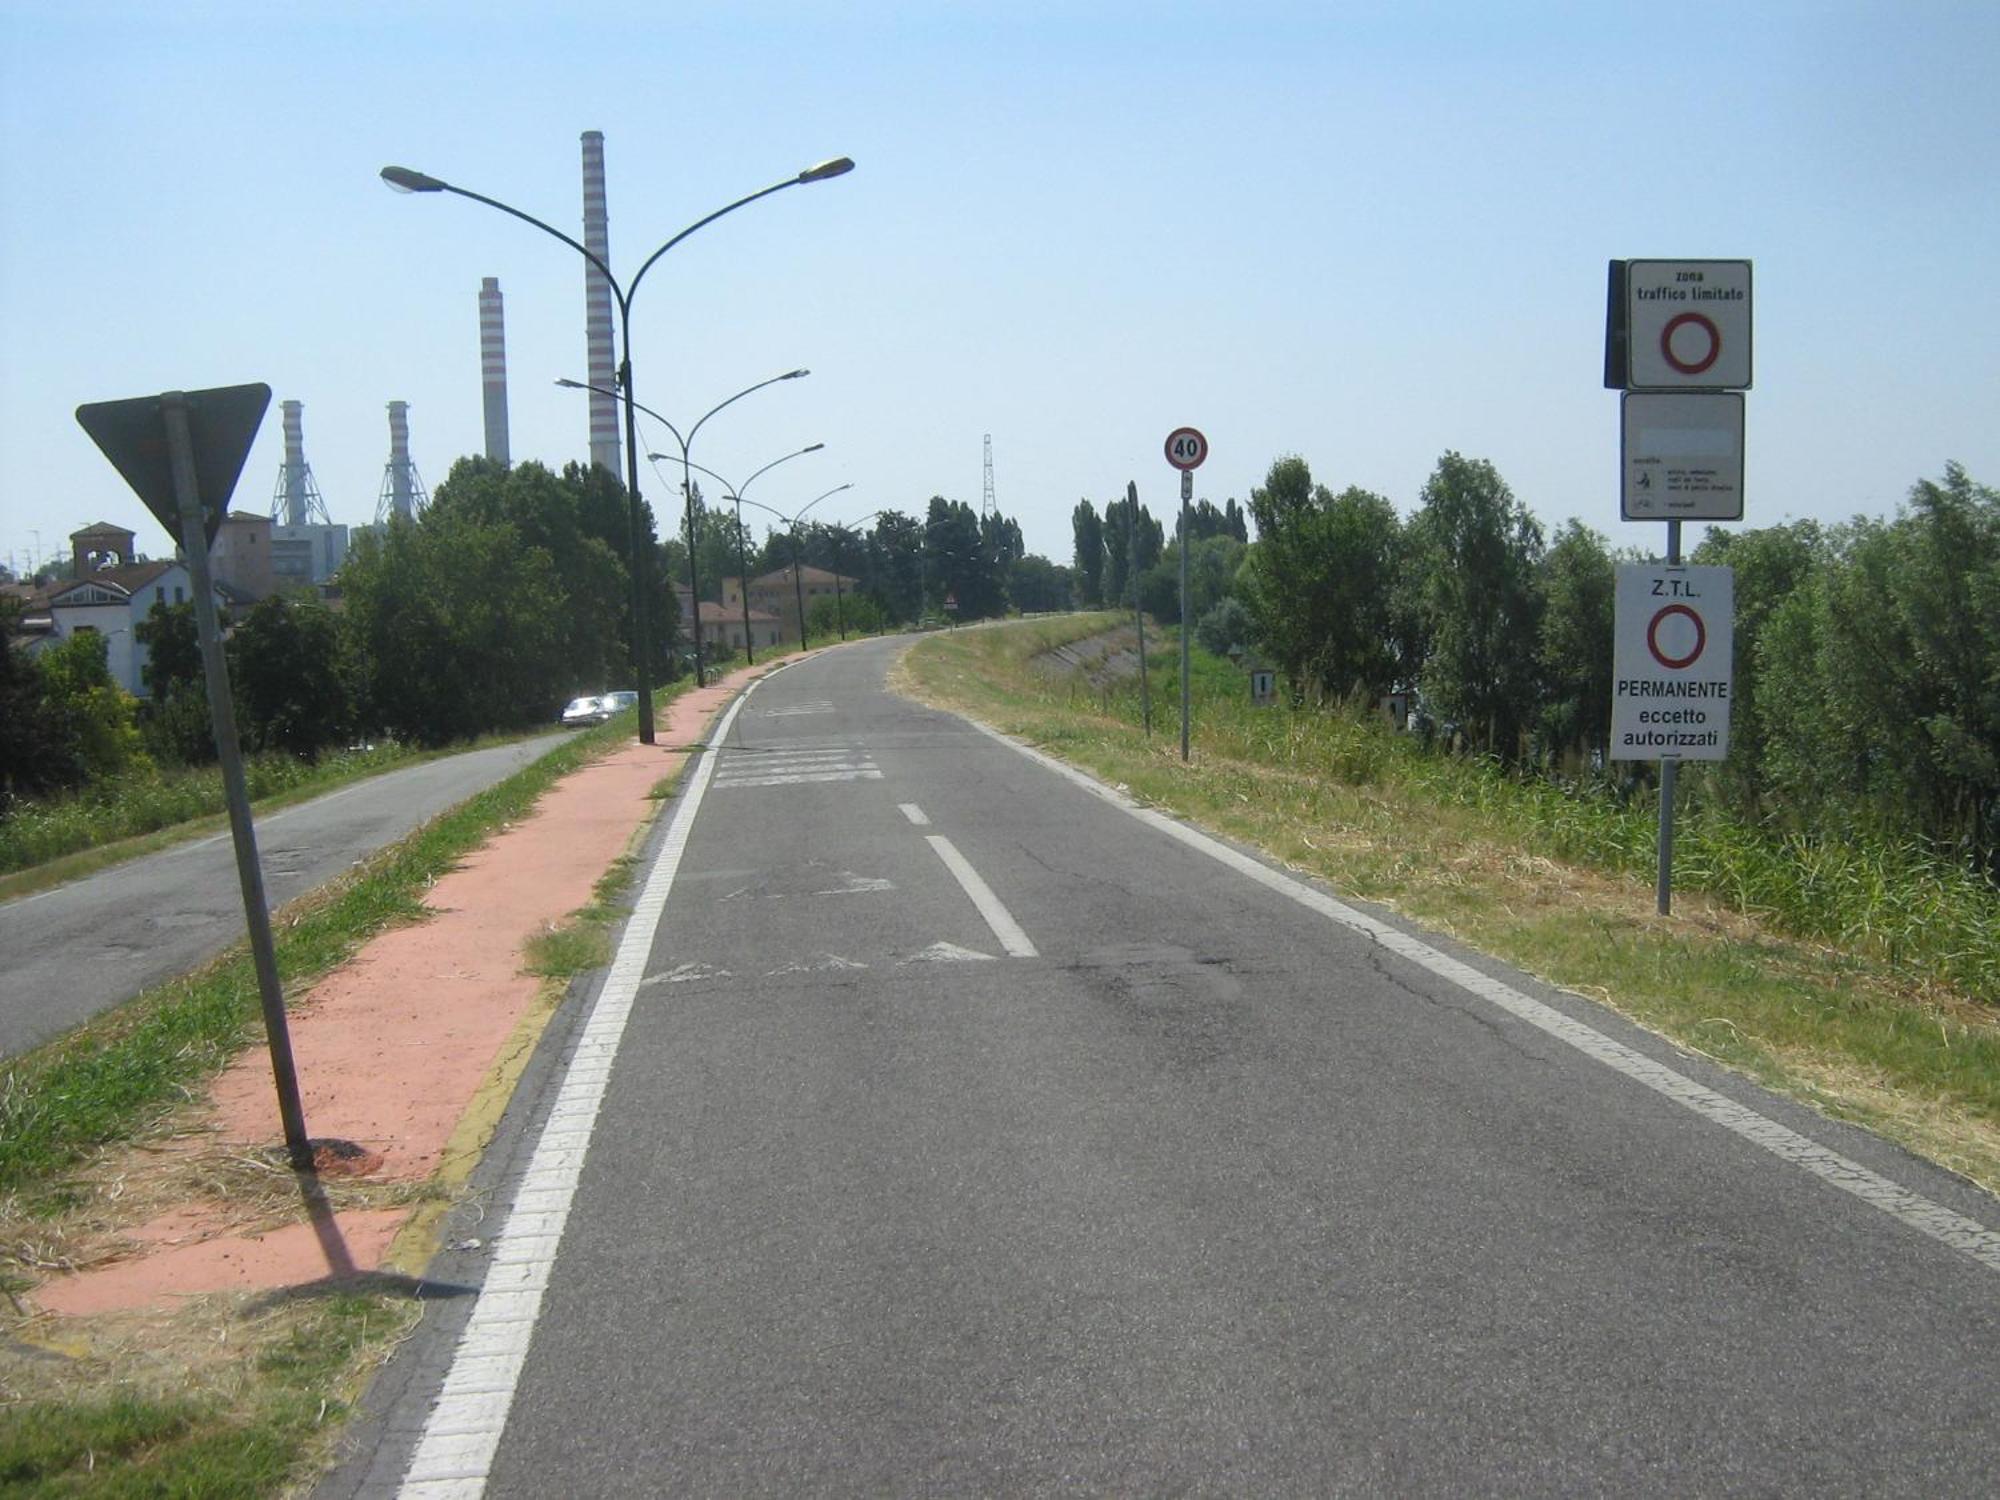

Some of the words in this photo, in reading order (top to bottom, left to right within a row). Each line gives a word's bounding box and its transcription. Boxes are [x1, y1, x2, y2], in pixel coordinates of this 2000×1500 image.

[1676, 271, 1704, 282] zona
[1637, 287, 1687, 300] traffico
[1692, 286, 1744, 300] limitato
[1174, 439, 1198, 457] 40
[1651, 579, 1701, 597] Z.T.L.
[1618, 680, 1728, 698] PERMANENTE
[1639, 709, 1706, 724] eccetto
[1623, 730, 1718, 746] autorizzati
